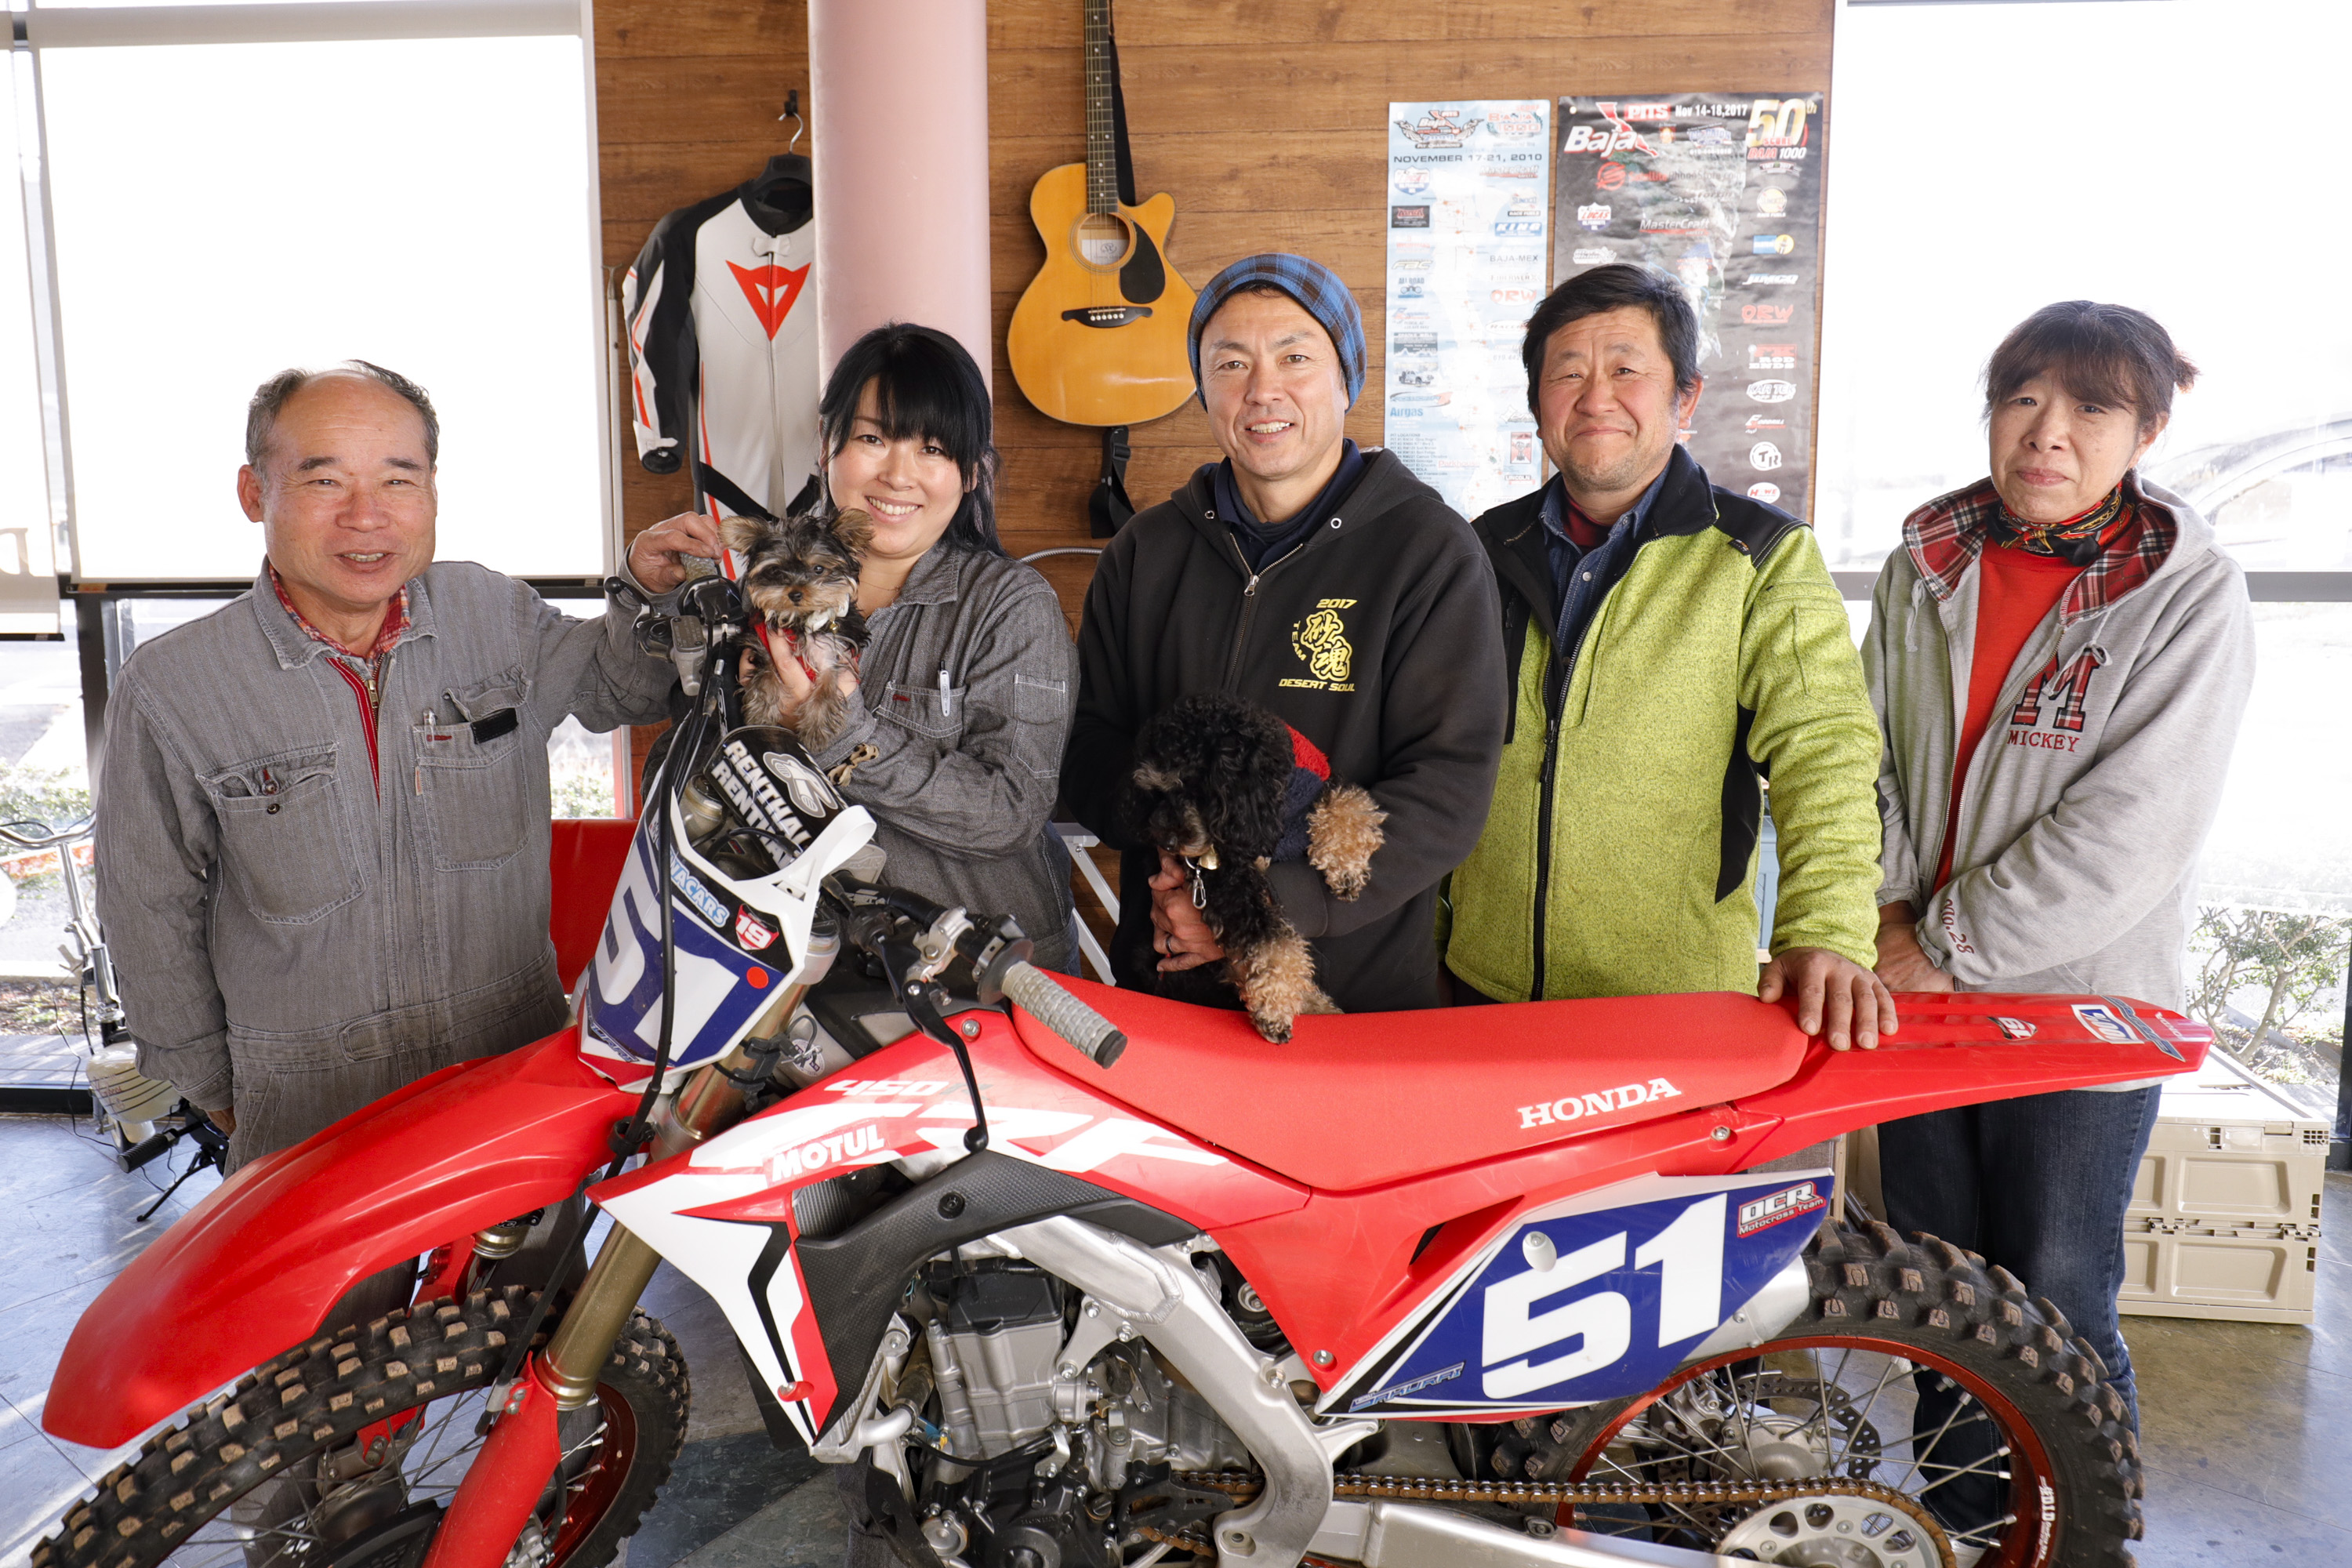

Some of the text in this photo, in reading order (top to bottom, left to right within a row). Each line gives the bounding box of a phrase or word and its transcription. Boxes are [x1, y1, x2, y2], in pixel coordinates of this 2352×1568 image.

[1488, 113, 1534, 122] BAJA
[1627, 104, 1668, 118] PITS
[1675, 103, 1748, 118] Nov 14-18,2017
[1563, 125, 1637, 158] Baja
[1764, 137, 1793, 146] SCORE
[1394, 154, 1463, 163] NOVEMBER
[1748, 147, 1807, 159] BAJA 1000
[1581, 211, 1610, 220] LUCAS
[1497, 223, 1542, 231] KING
[1640, 219, 1709, 230] MasterCraft
[1490, 289, 1537, 303] ORW
[1741, 304, 1794, 320] ORW
[1748, 384, 1797, 394] KAR TEK
[1390, 407, 1424, 418] Airgas
[1316, 599, 1357, 608] 2017
[1292, 621, 1307, 661] TEAM
[1279, 679, 1327, 689] DESERT
[2007, 730, 2080, 753] MICKEY
[736, 914, 772, 949] 19
[1998, 1017, 2032, 1039] 19
[1518, 1077, 1682, 1129] HONDA
[772, 1123, 886, 1181] MOTUL
[1740, 1199, 1824, 1236] Motocross Team
[1482, 1192, 1728, 1399] 51
